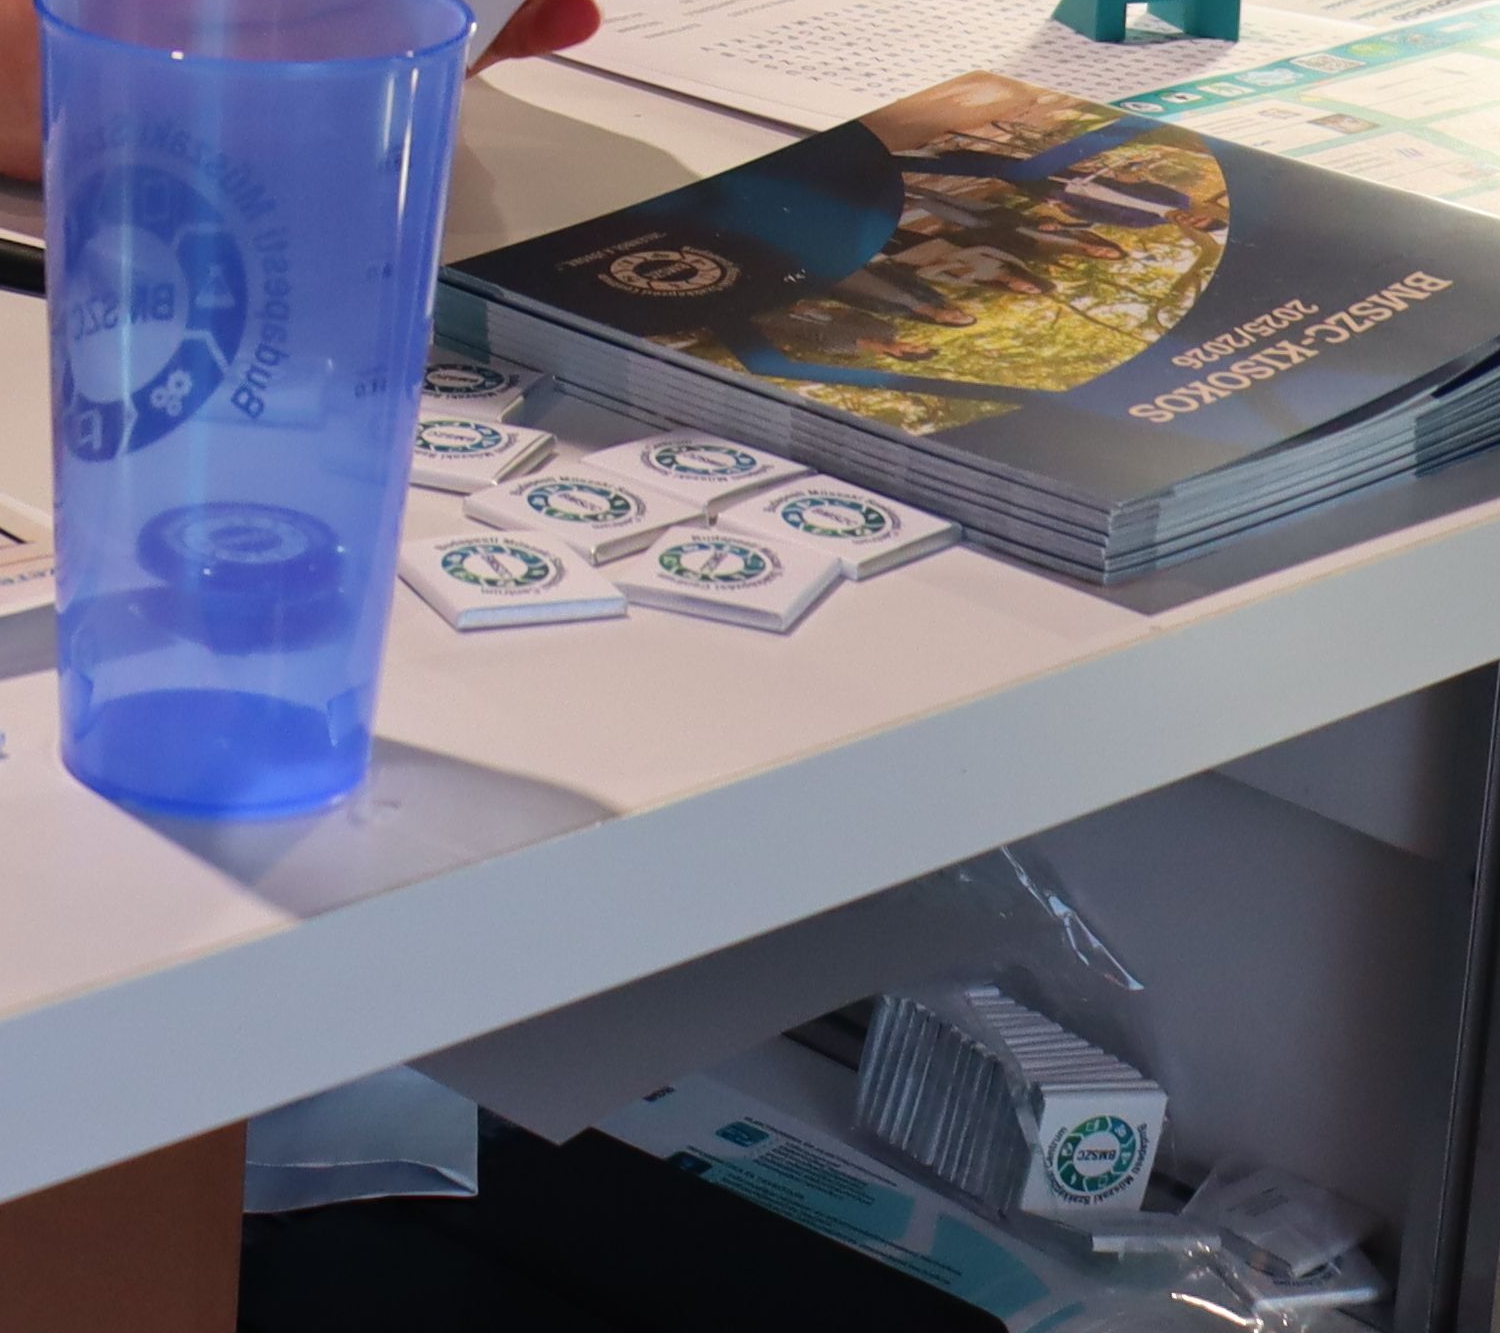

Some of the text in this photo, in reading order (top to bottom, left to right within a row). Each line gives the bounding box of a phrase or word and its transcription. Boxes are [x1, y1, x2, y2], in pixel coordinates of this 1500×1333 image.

[1128, 271, 1453, 423] BMSZC-KISOKOS
[1172, 299, 1320, 369] 2025/2026
[1077, 1148, 1117, 1162] BMSZC
